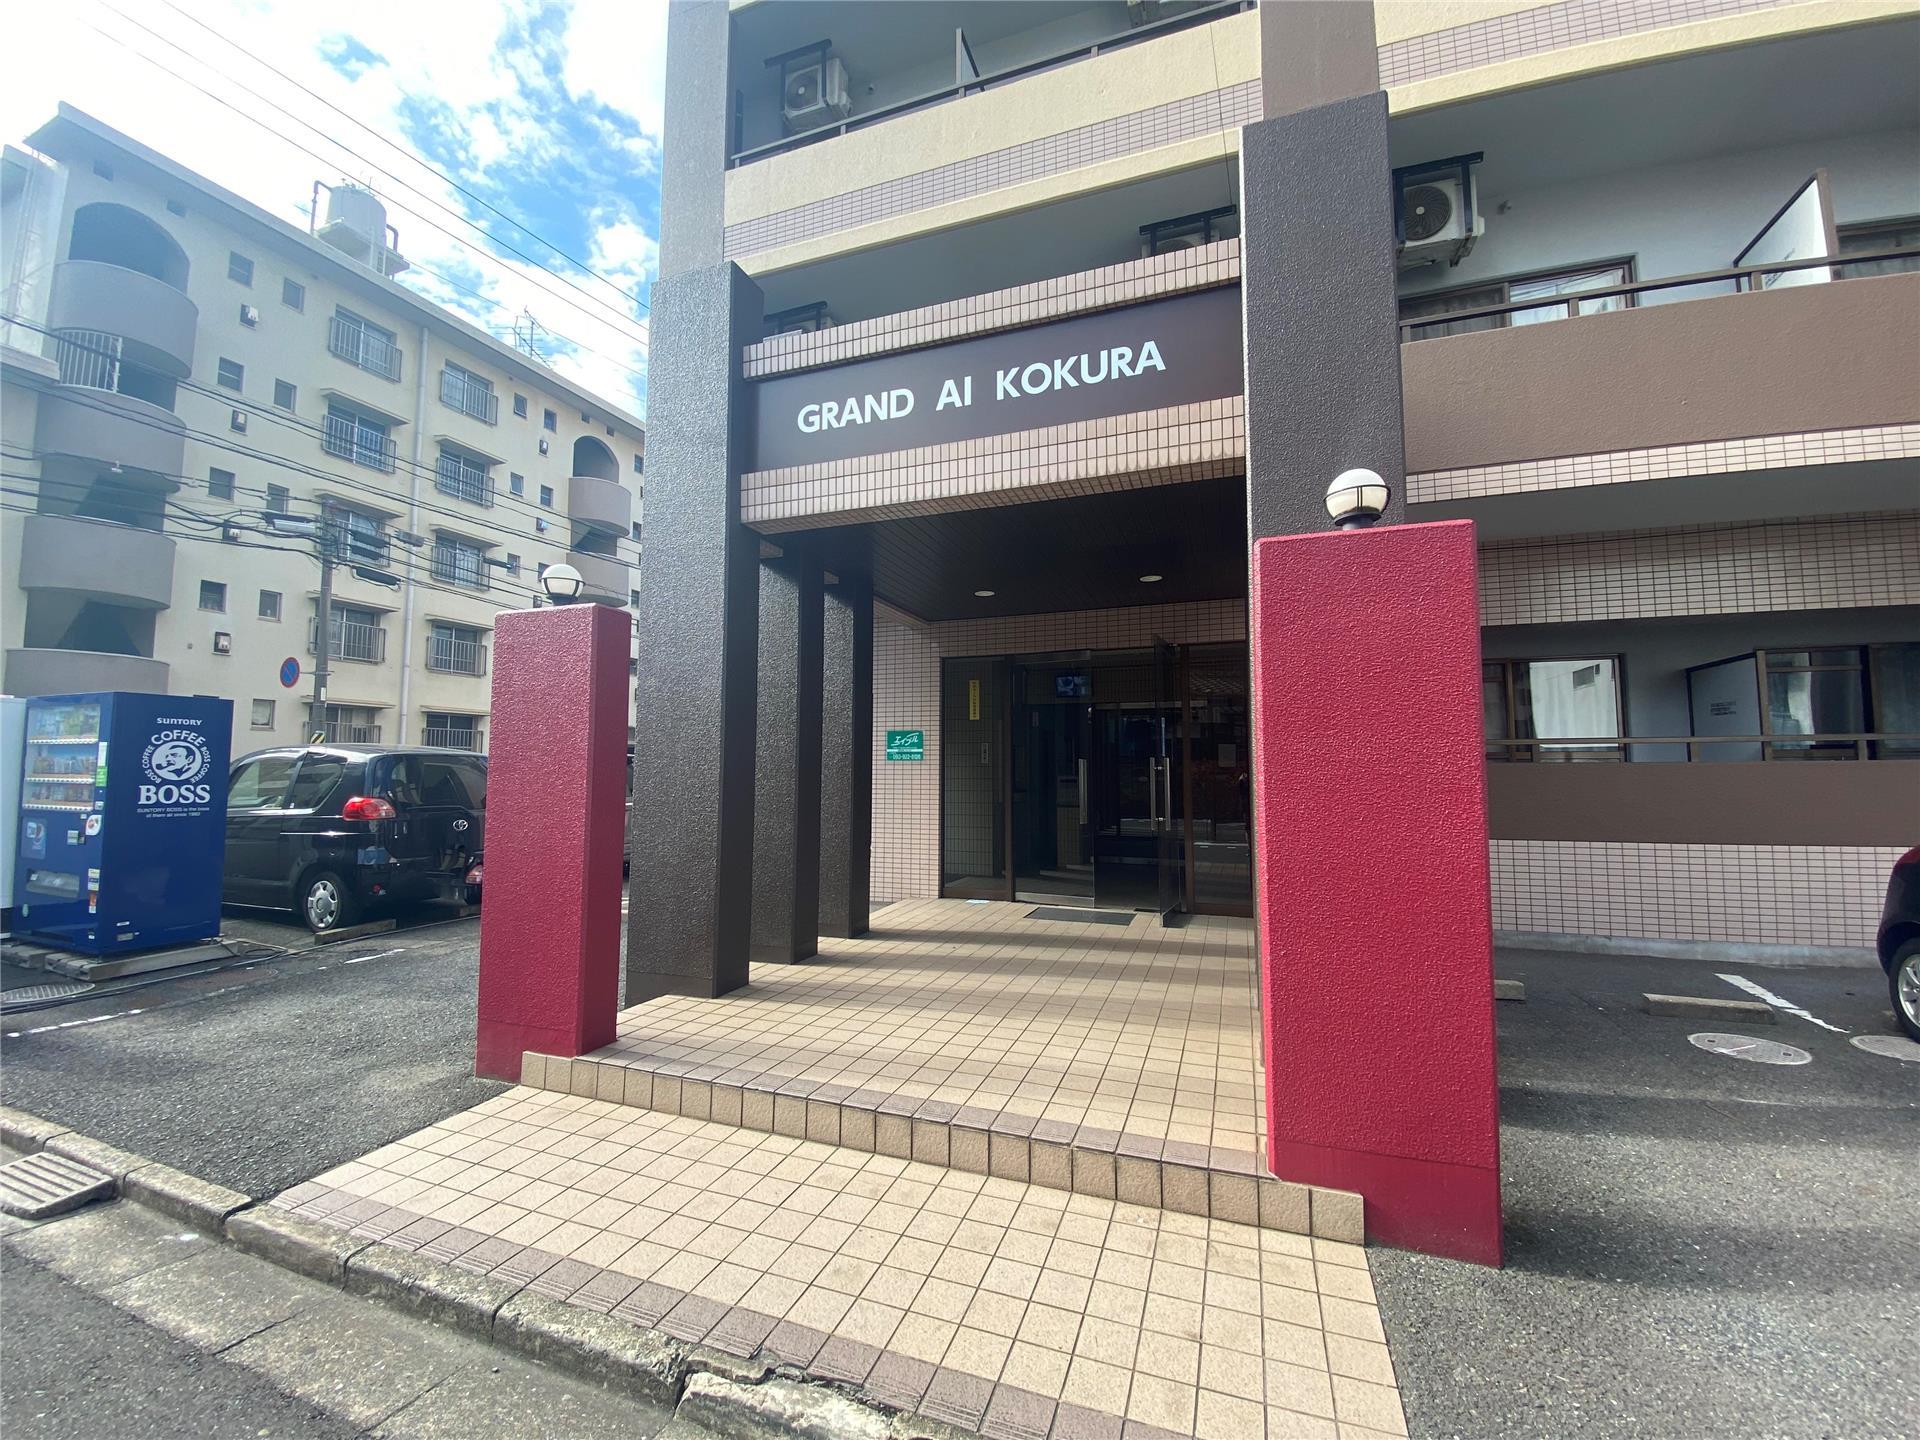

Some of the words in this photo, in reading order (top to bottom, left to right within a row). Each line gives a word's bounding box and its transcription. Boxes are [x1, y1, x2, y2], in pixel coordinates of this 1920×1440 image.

[797, 387, 914, 434] GRAND
[936, 375, 972, 412] AI
[996, 339, 1167, 400] KOKURA
[151, 729, 206, 746] COFFEE
[142, 745, 155, 769] COFFEE
[200, 746, 211, 762] BOSS
[190, 763, 210, 784] COFFEE
[138, 784, 211, 805] BOSS
